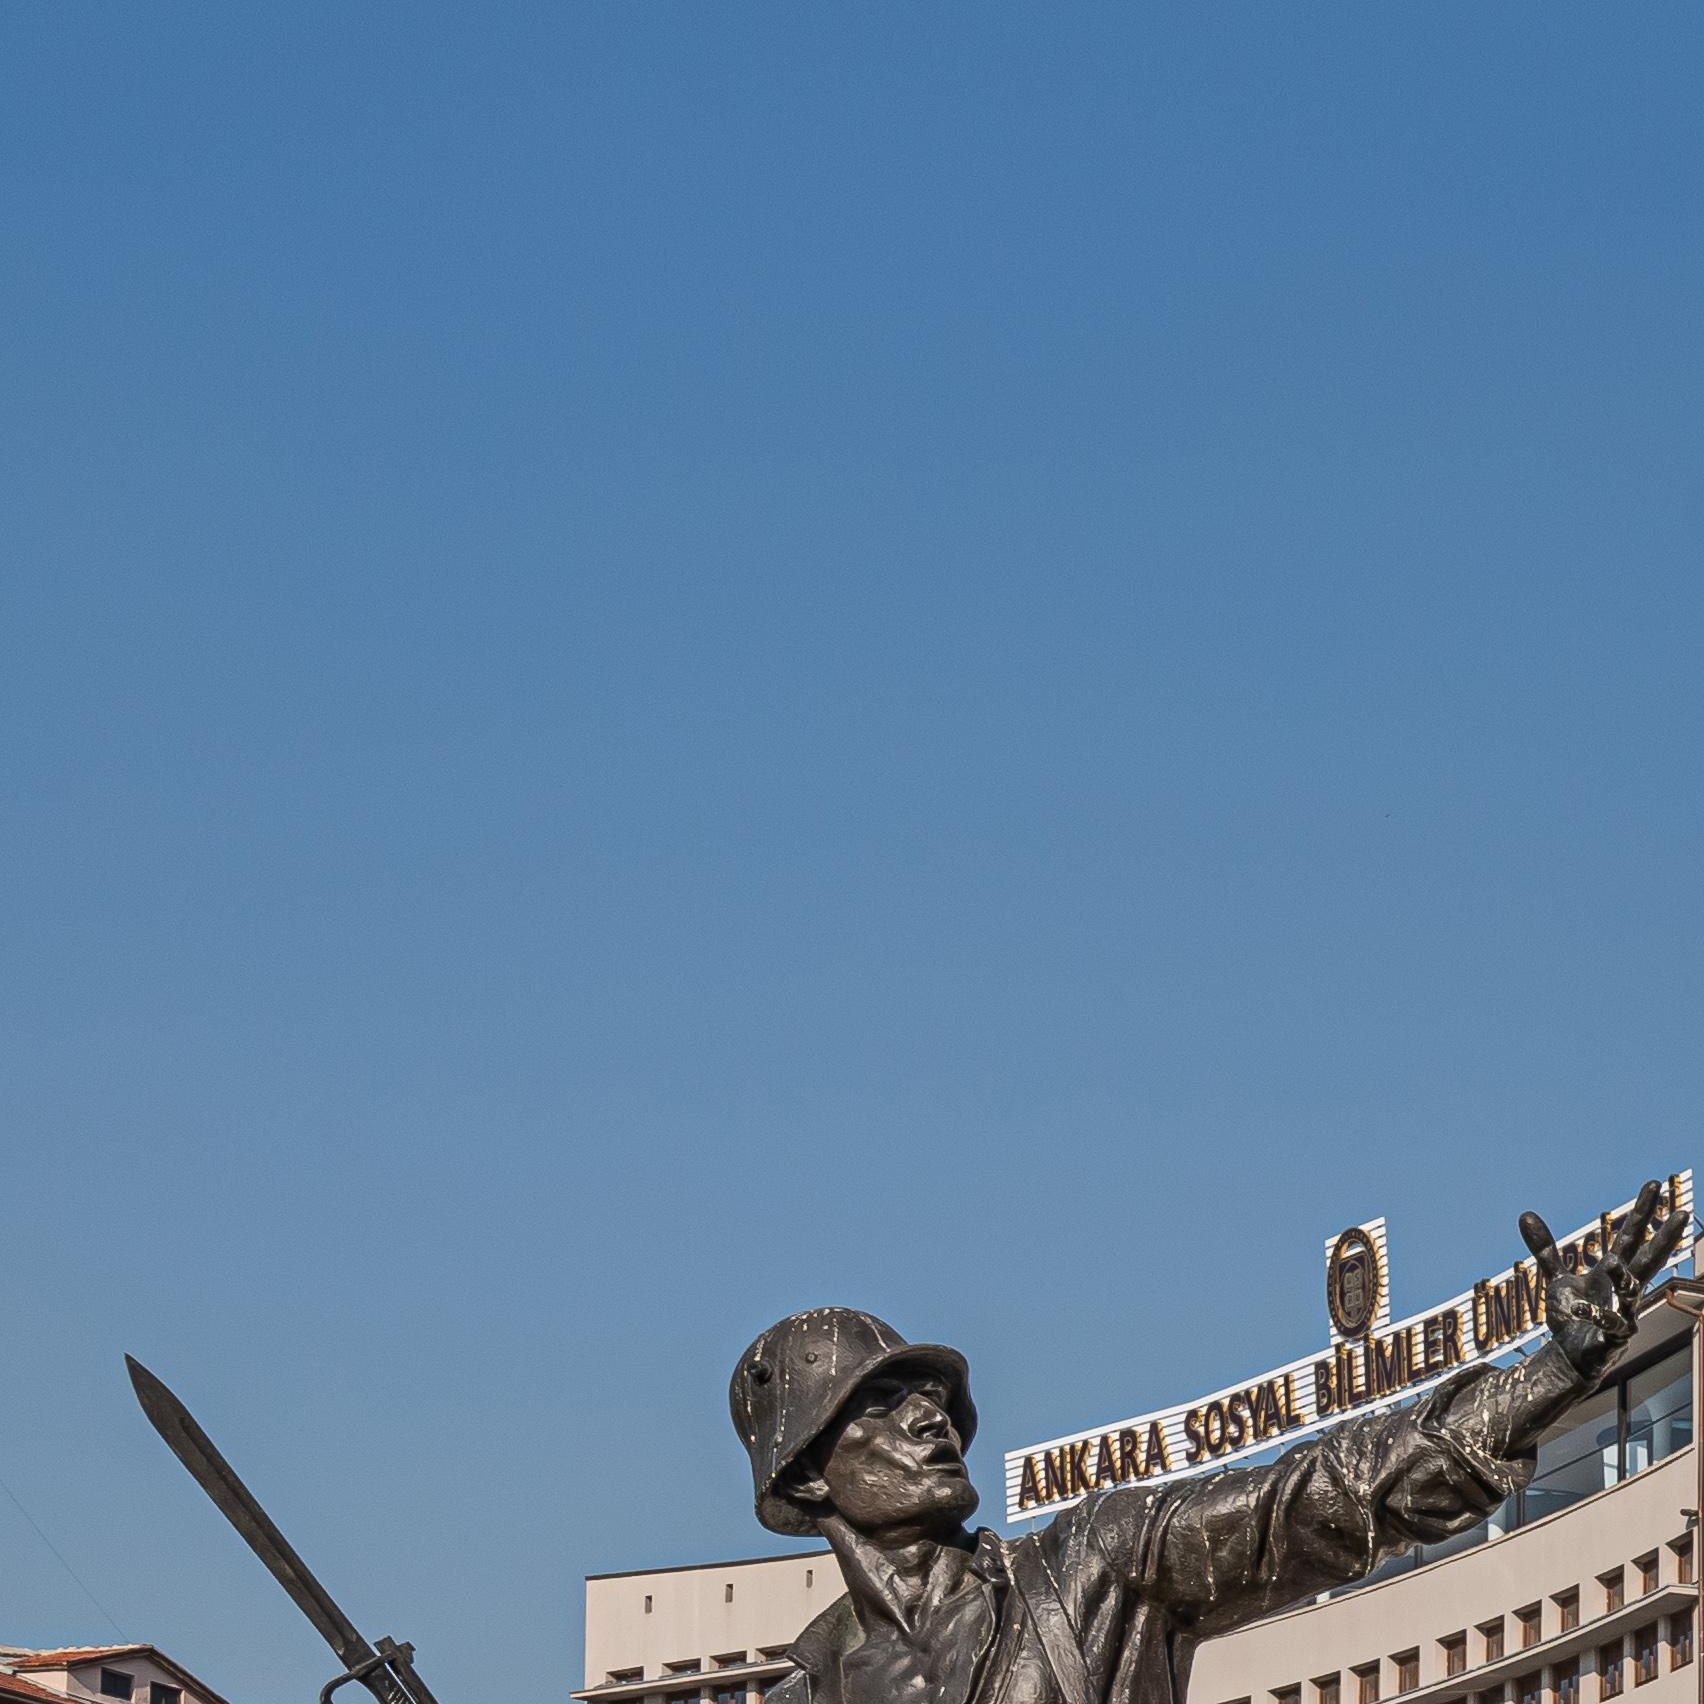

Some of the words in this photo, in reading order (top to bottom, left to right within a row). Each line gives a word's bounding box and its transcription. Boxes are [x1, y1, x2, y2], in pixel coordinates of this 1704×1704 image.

[1019, 1421, 1172, 1509] ANKARA
[1184, 1373, 1304, 1464] SOSYAL
[1315, 1308, 1466, 1417] BİLİMLER
